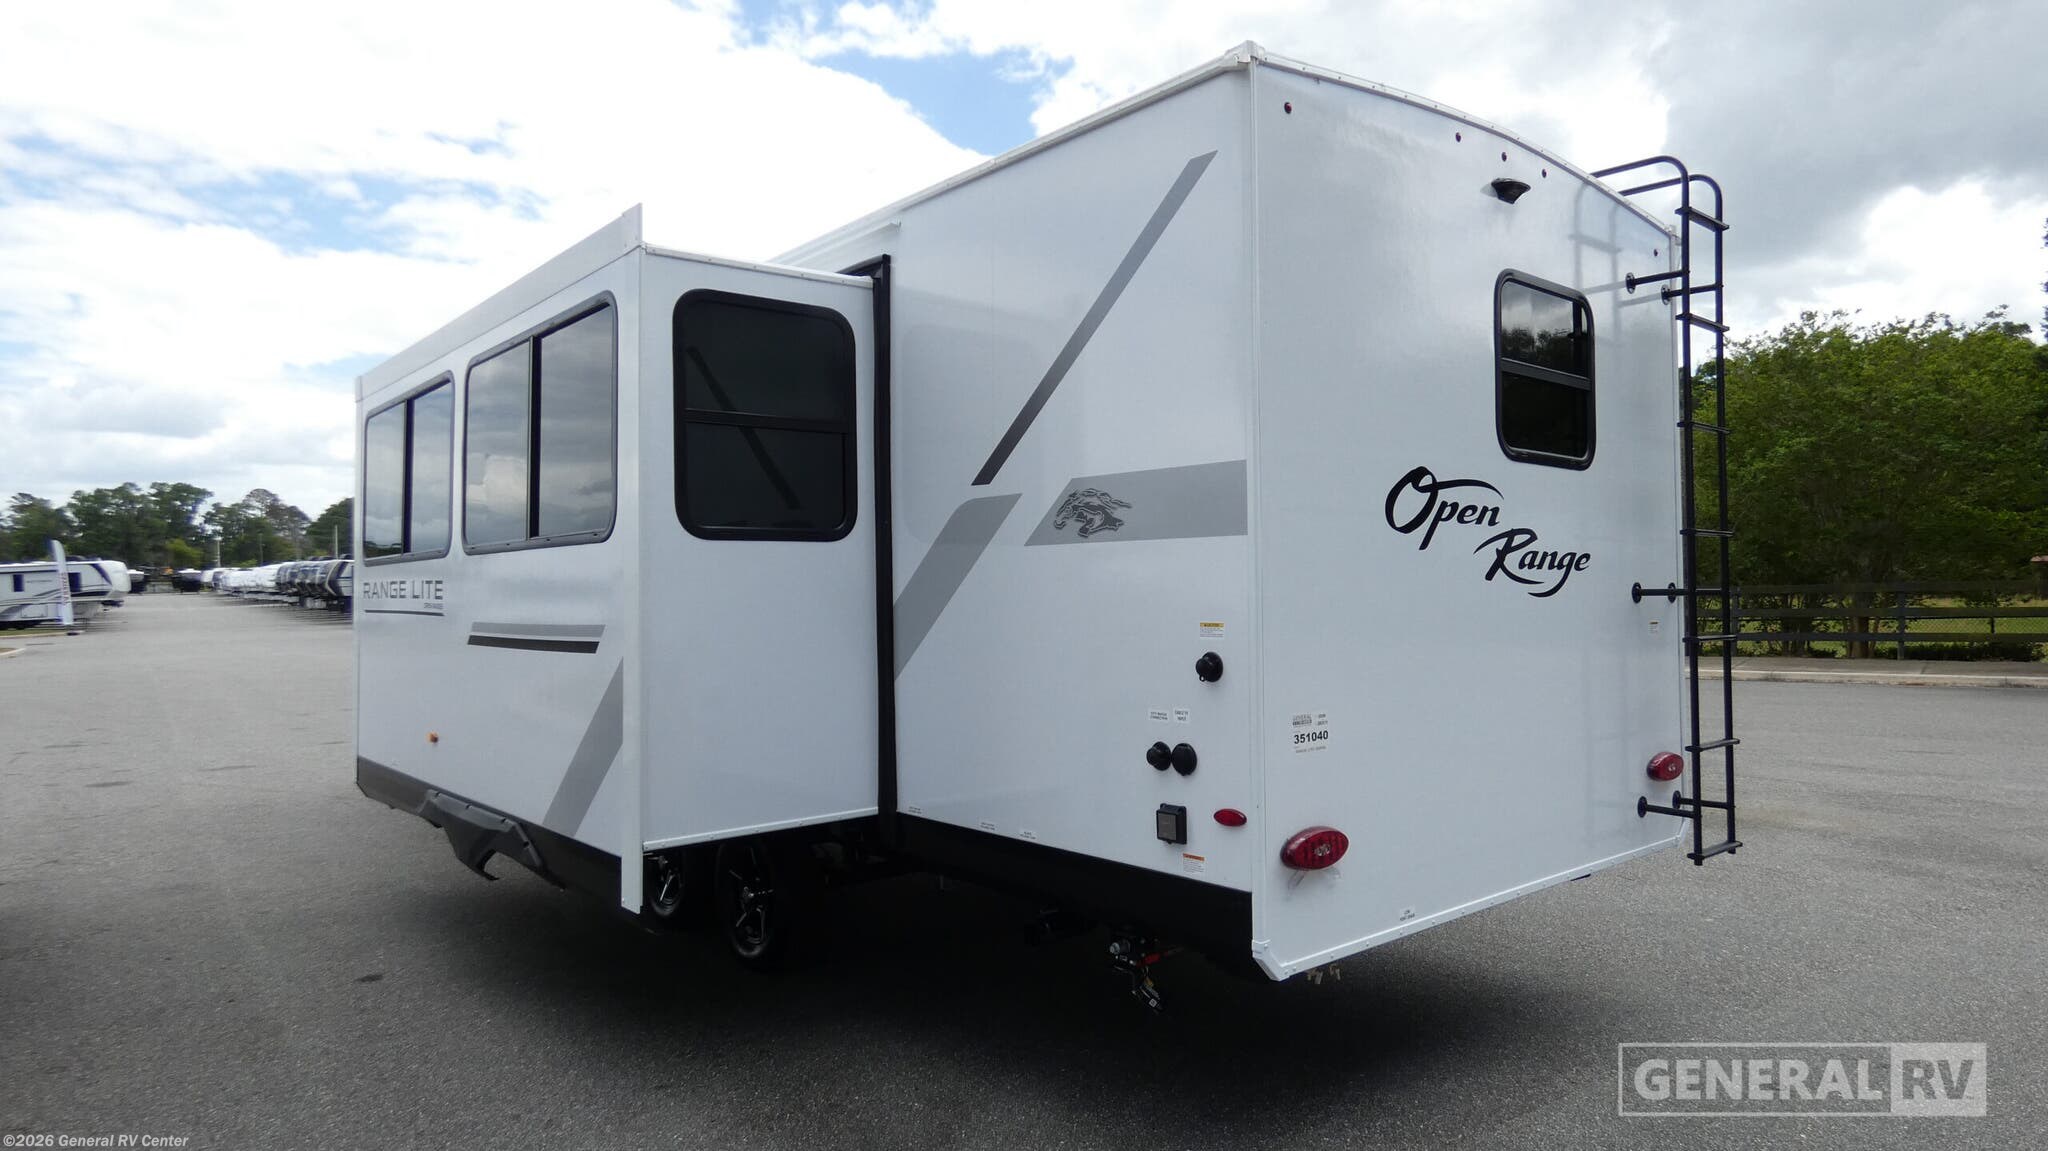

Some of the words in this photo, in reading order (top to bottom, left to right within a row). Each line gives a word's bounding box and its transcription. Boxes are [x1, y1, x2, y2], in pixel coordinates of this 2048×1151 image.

[1385, 466, 1504, 550] Open
[1473, 528, 1591, 598] Range
[363, 581, 407, 599] RANGE
[412, 580, 443, 600] LITE
[1294, 730, 1329, 745] 351040
